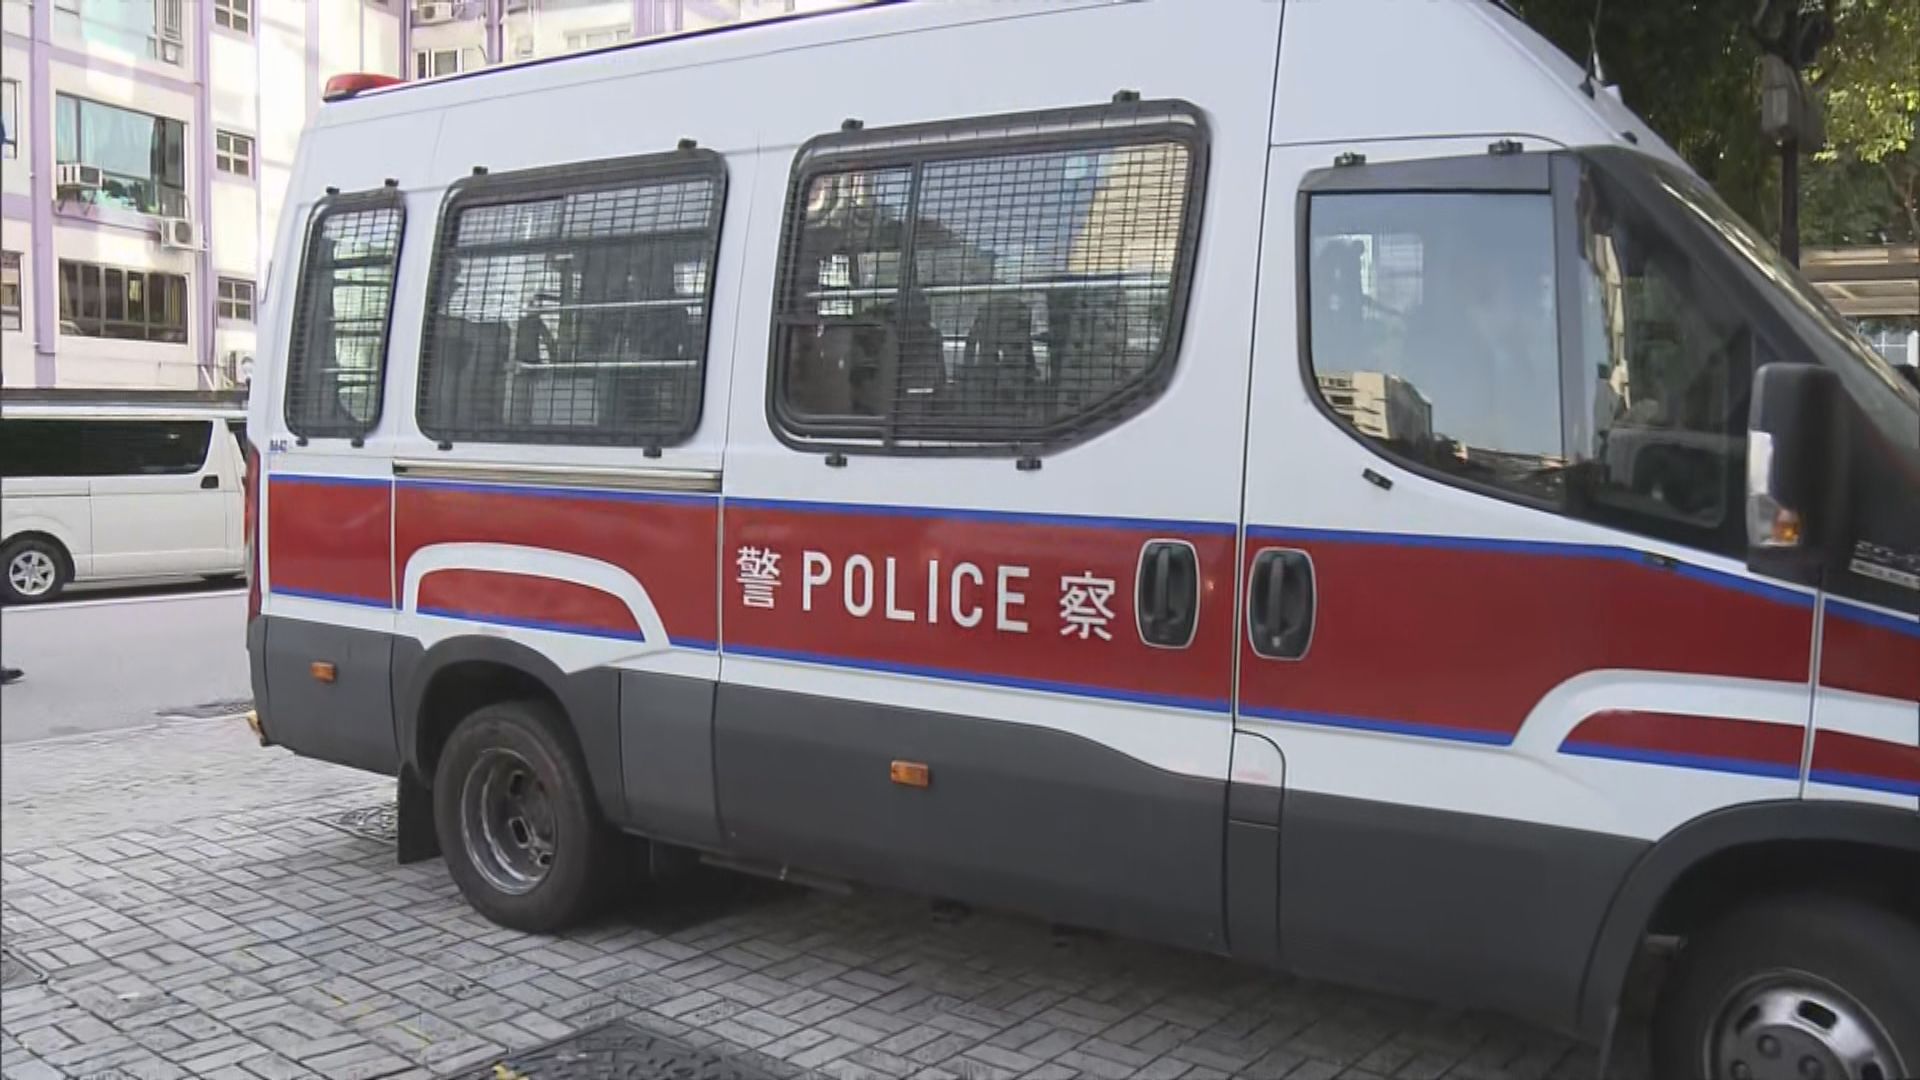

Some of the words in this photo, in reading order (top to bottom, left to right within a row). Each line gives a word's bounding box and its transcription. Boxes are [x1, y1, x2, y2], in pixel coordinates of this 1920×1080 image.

[736, 546, 782, 609] 警
[802, 550, 1030, 633] POLICE
[1059, 571, 1116, 641] 察
